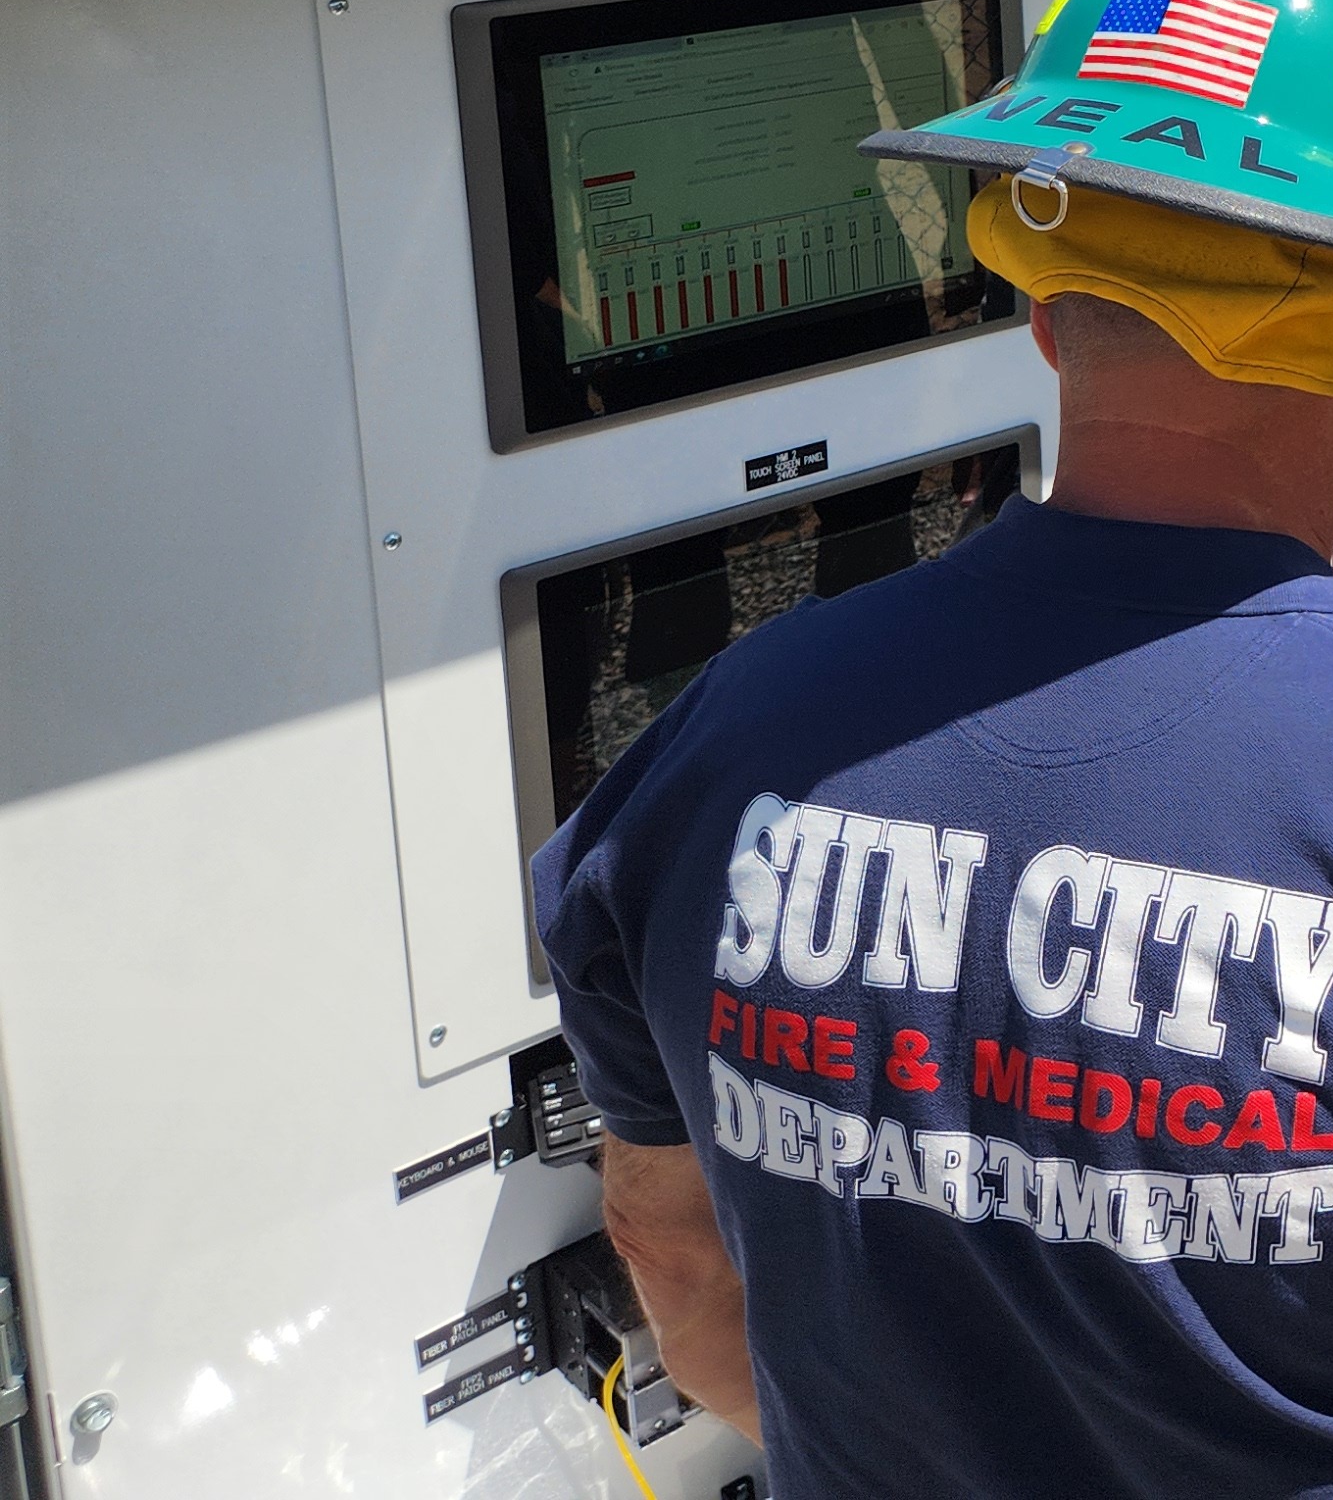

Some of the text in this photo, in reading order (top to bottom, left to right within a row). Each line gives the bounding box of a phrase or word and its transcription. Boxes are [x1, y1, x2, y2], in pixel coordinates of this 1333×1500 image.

[955, 93, 1300, 183] NEAL
[749, 451, 825, 480] TOUCH SCREEN PANEL
[791, 450, 797, 460] 2
[714, 791, 988, 994] SUN
[708, 990, 857, 1081] FIRE
[885, 1028, 942, 1093] &
[399, 1140, 489, 1188] KEYBOARD & MOUSE
[422, 1309, 509, 1361] FIBER PATCH PANEL
[430, 1365, 515, 1415] FIBER PATCH PANEL
